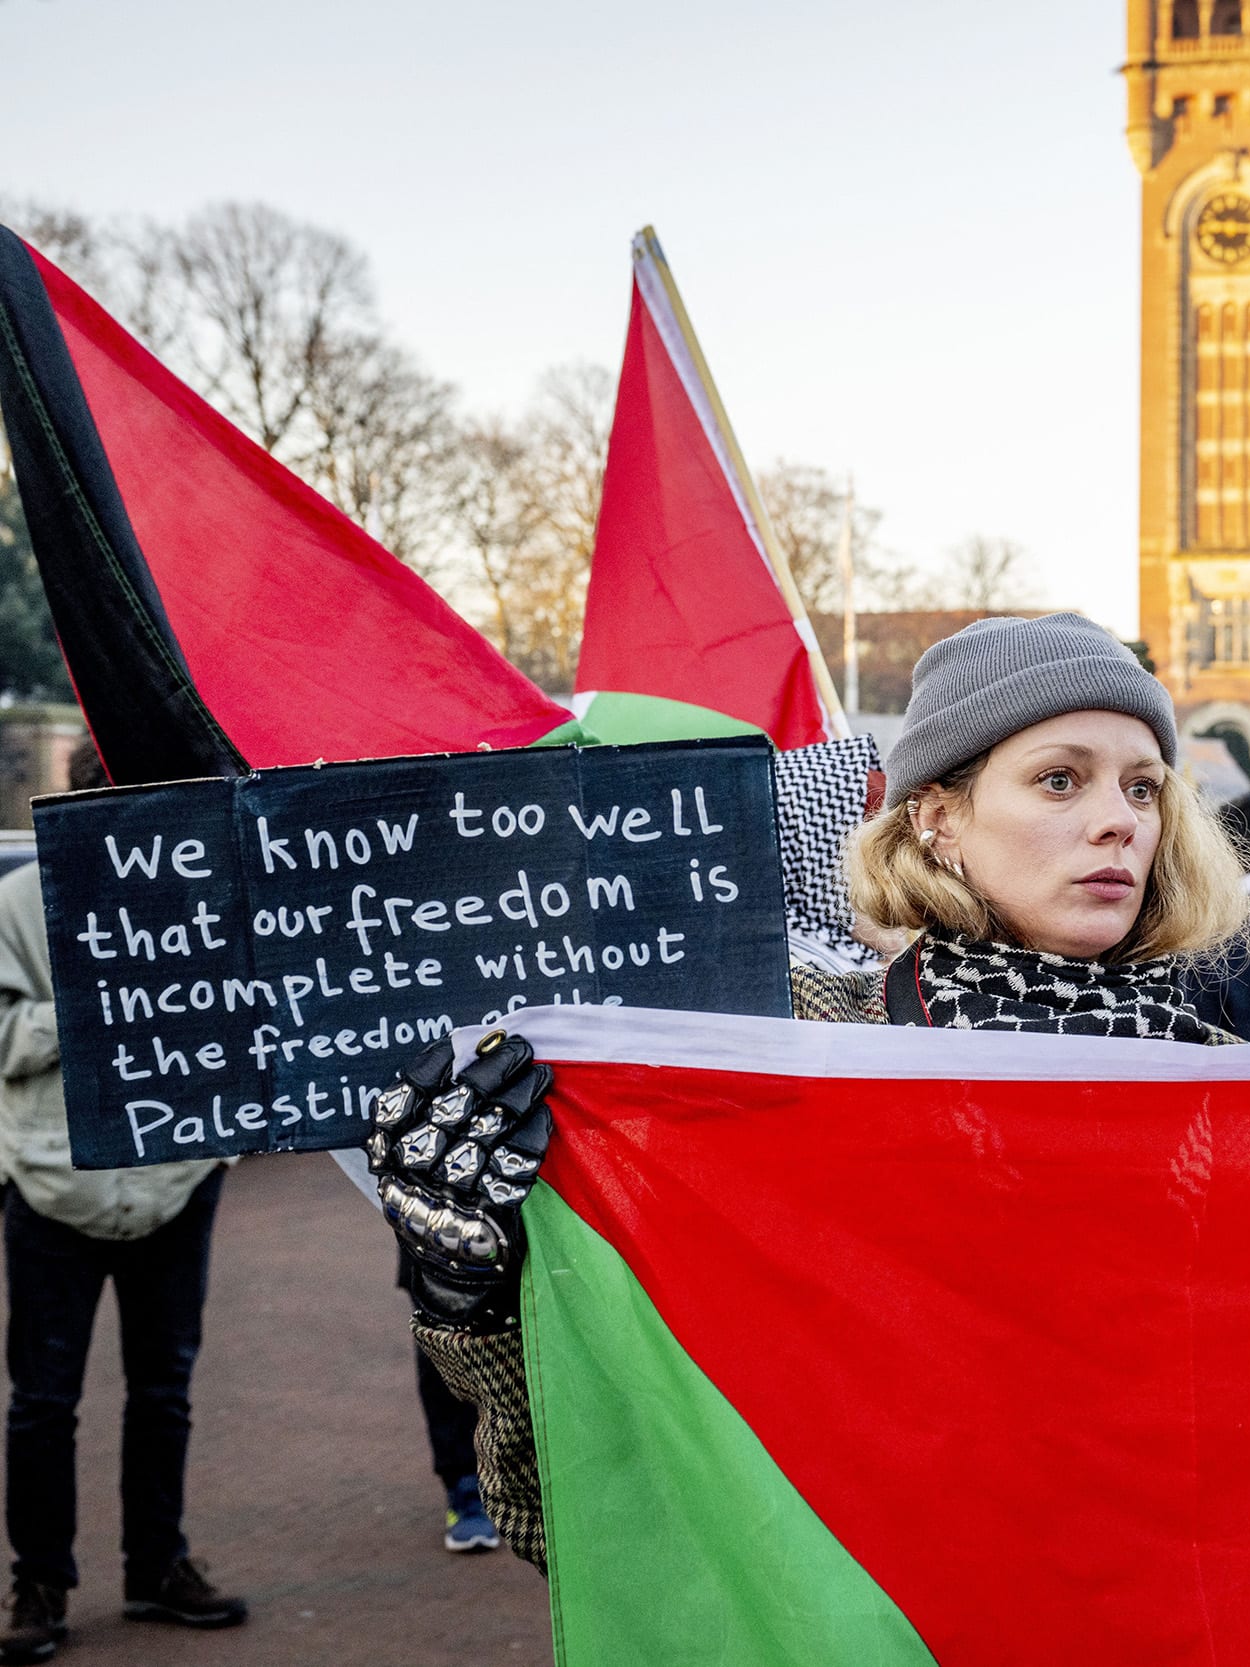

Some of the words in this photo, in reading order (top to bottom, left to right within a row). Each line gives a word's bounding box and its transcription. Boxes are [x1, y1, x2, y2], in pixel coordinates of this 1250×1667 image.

[105, 834, 213, 880] We
[256, 813, 419, 874] know
[448, 791, 547, 838] too
[567, 786, 724, 843] well
[77, 900, 227, 961] that
[253, 905, 333, 938] our
[345, 869, 636, 956] freedom
[689, 858, 739, 903] is
[100, 951, 443, 1027] incomplete
[475, 926, 685, 981] without
[112, 1036, 227, 1081] the
[249, 1014, 453, 1070] freedom
[125, 1072, 402, 1158] Palestin
